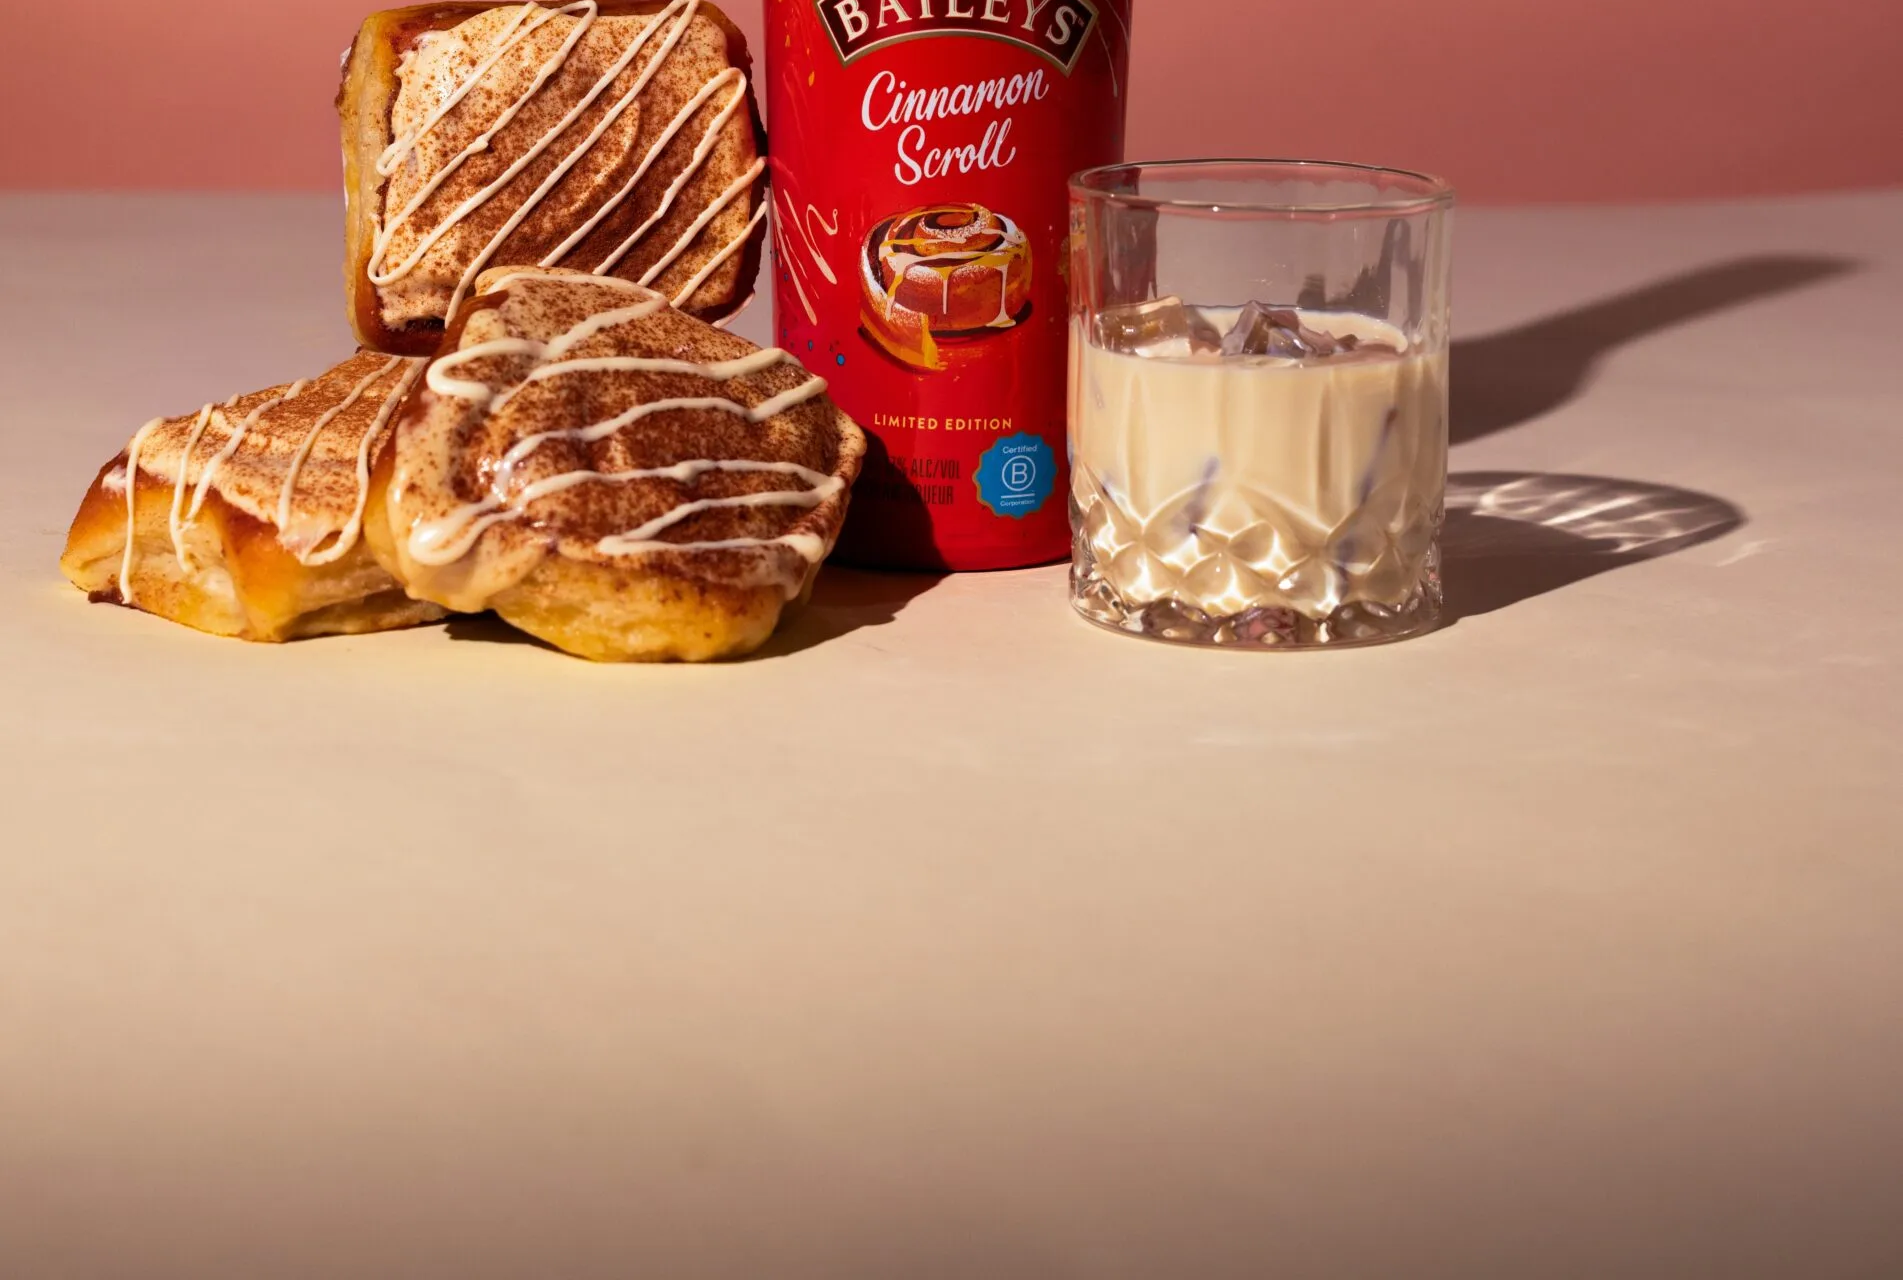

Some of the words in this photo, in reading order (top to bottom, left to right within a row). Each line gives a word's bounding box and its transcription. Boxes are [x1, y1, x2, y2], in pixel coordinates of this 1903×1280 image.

[861, 69, 1050, 131] Cinnamon
[894, 118, 1016, 185] Scroll
[874, 413, 938, 431] LIMITED
[944, 418, 1012, 431] EDITION
[1002, 445, 1038, 454] Certified
[911, 458, 960, 480] ALC/VOL
[1011, 462, 1028, 485] B
